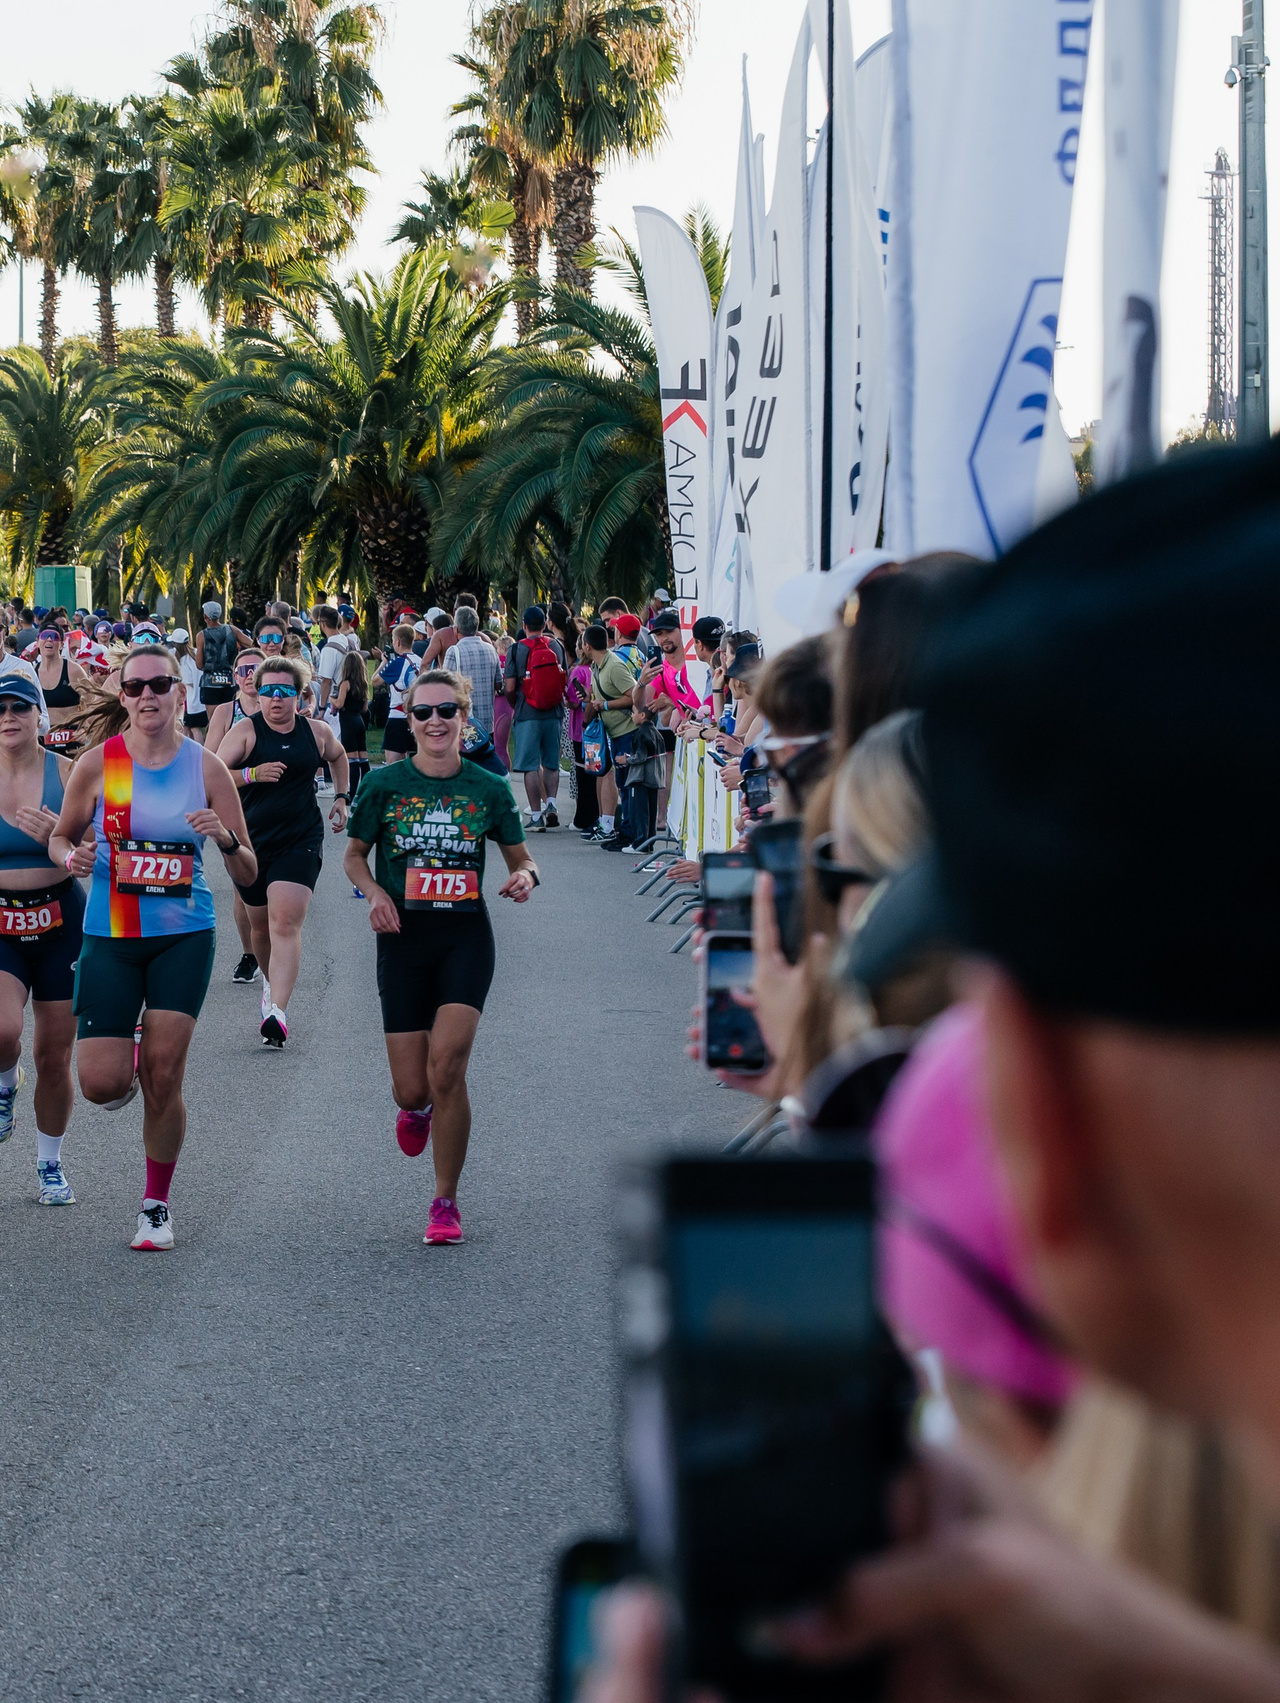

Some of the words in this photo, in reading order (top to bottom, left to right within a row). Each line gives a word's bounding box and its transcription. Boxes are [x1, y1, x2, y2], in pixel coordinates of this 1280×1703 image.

[50, 731, 70, 742] 7617
[412, 823, 460, 838] МИР
[441, 839, 477, 854] RUN
[131, 856, 182, 880] 7279
[145, 885, 166, 894] ЕЛЕНА
[420, 873, 467, 895] 7175
[433, 901, 453, 909] ЕЛЕНА
[3, 908, 52, 930] 7330
